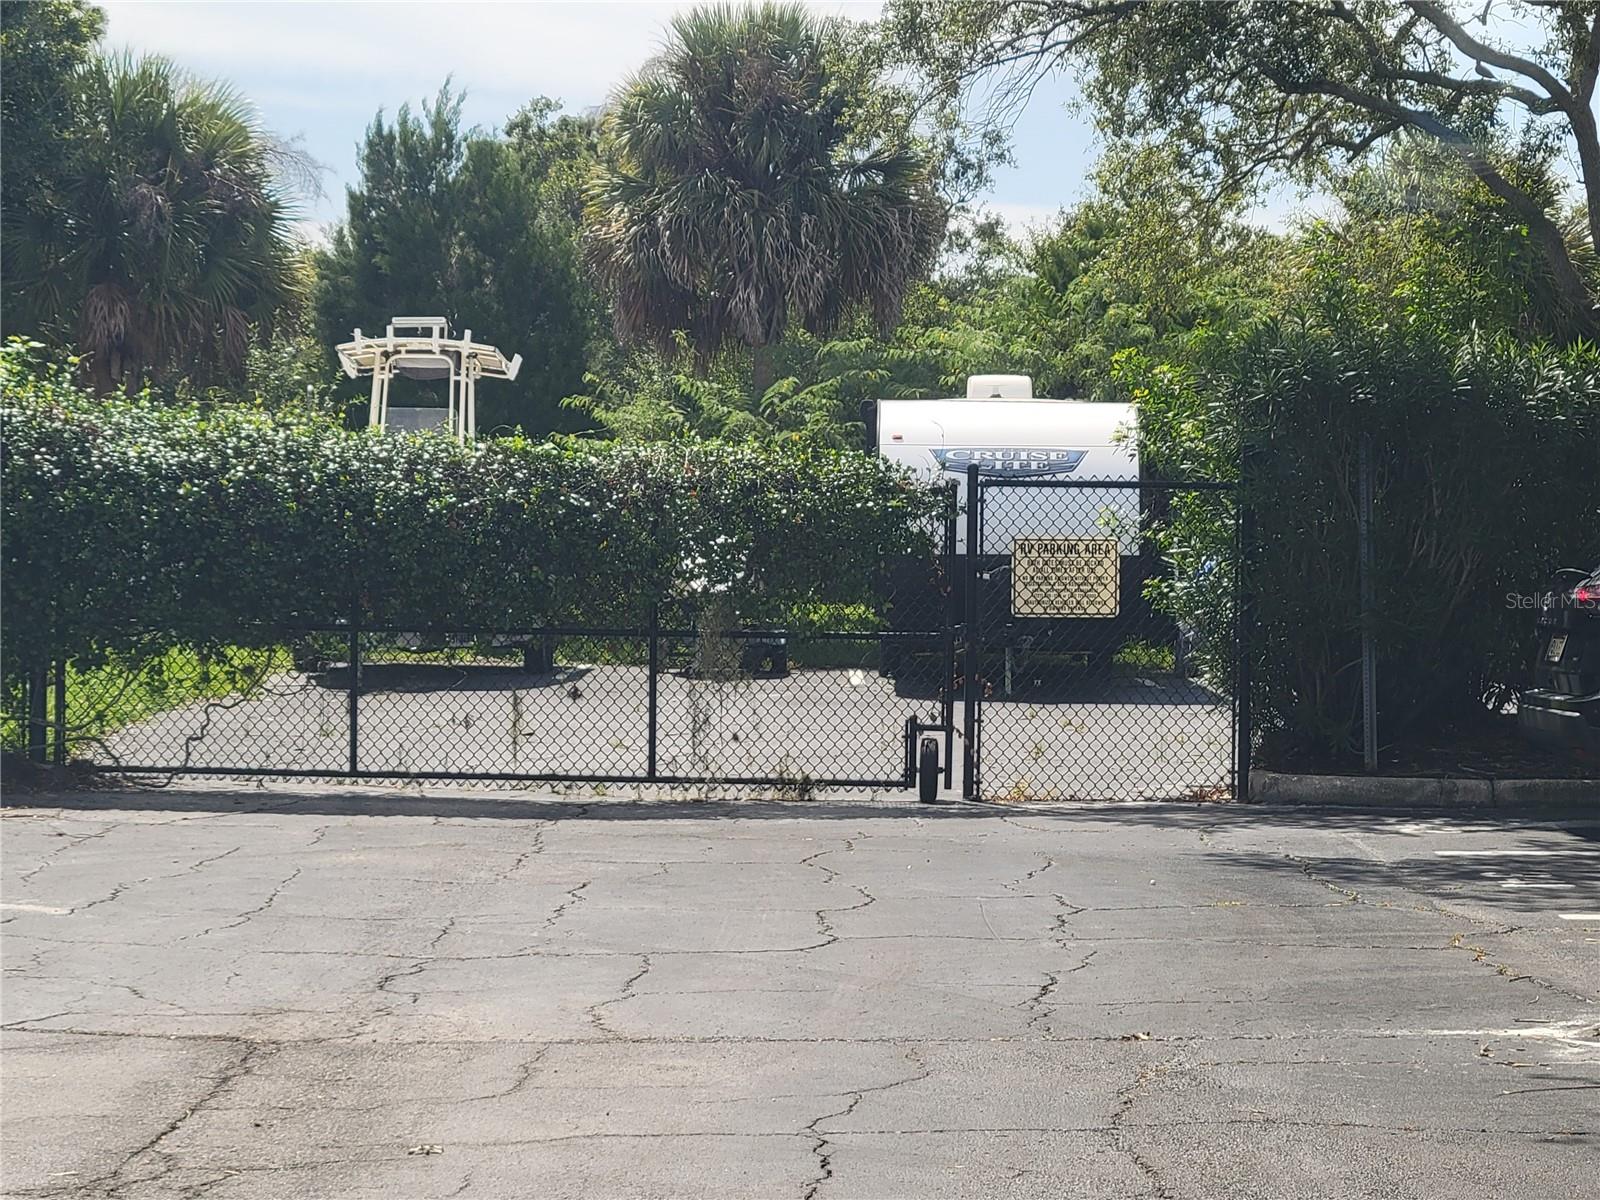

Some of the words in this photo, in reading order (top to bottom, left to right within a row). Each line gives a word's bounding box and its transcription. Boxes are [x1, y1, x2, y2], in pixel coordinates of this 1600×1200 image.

[945, 449, 1069, 461] CRUISE
[1020, 543, 1034, 555] RV
[1038, 543, 1080, 555] PARKING
[1085, 543, 1111, 555] AREA
